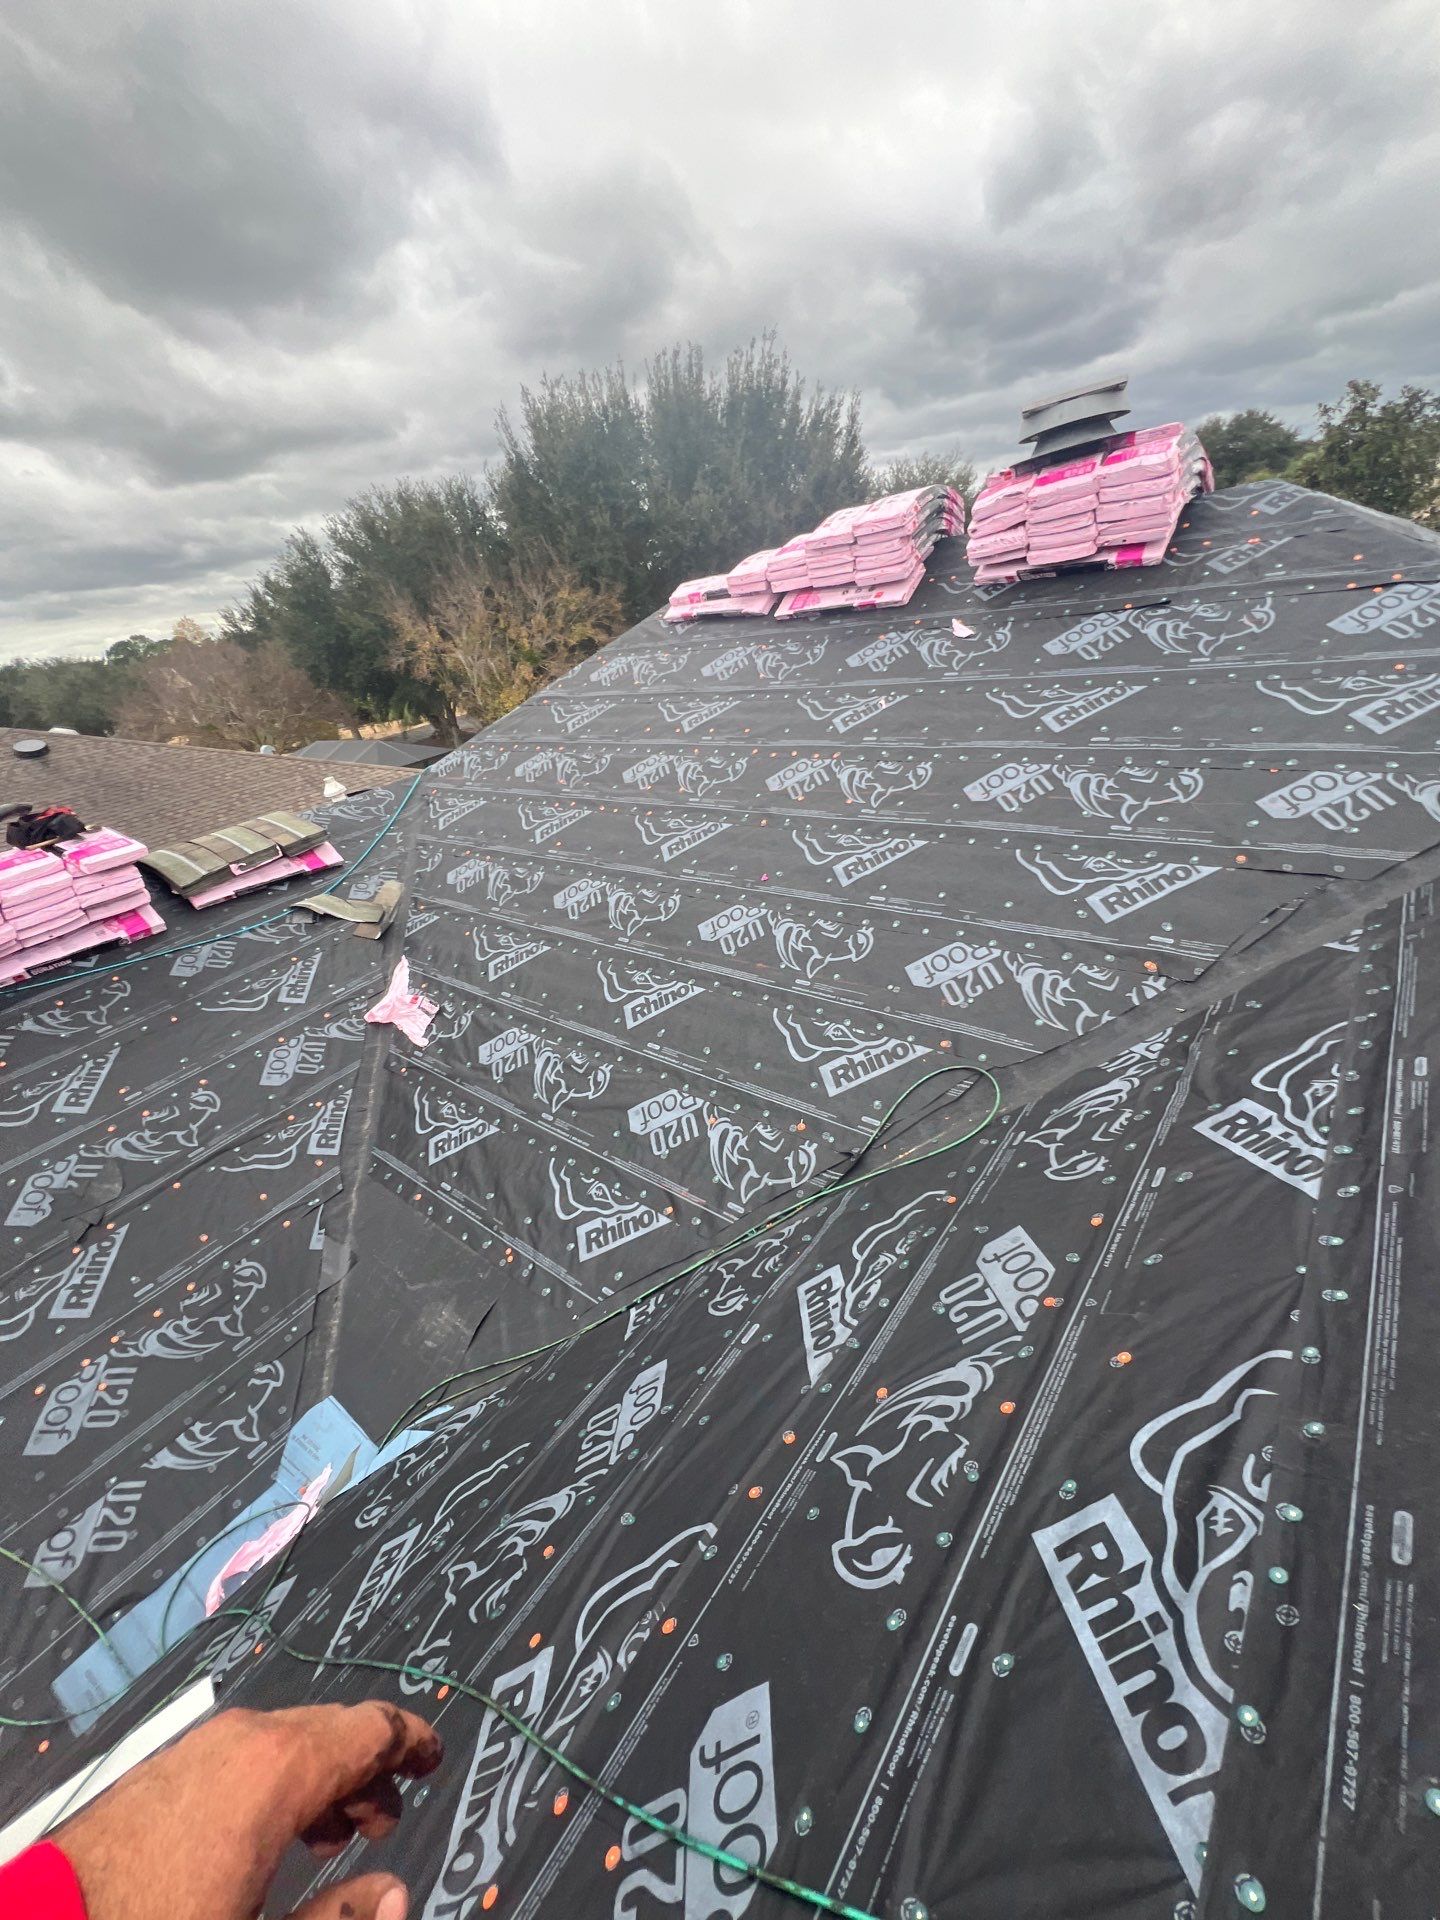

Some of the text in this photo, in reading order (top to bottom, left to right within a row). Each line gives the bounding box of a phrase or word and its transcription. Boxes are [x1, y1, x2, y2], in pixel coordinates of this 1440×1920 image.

[1348, 583, 1434, 631] Roof
[1076, 626, 1132, 660] U20
[996, 774, 1055, 812] U20
[1278, 772, 1375, 815] Roof
[1311, 786, 1397, 831] U20
[843, 840, 914, 878] Rhino
[1100, 865, 1200, 914] Rhino
[719, 919, 765, 955] U20
[923, 945, 993, 984] Roof
[940, 962, 1005, 1006] U20
[632, 985, 694, 1022] Rhino
[295, 1041, 326, 1075] U20
[492, 1046, 529, 1081] U20
[830, 1040, 916, 1088] Rhino
[315, 1092, 350, 1149] Rhino
[640, 1093, 698, 1132] Roof
[650, 1113, 699, 1156] U20
[434, 1121, 491, 1159] Rhino
[1210, 1110, 1325, 1177] Rhino
[585, 1208, 659, 1254] Rhino
[981, 1242, 1050, 1324] Roof
[804, 1275, 837, 1352] Rhino
[939, 1272, 1008, 1345] U20
[82, 1366, 138, 1428] U20
[618, 1376, 661, 1452] Roof
[574, 1403, 622, 1474] U20
[90, 1480, 147, 1552] U20
[1053, 1520, 1208, 1776] Rhino
[442, 1671, 536, 1897] Rhino
[699, 1733, 768, 1920] oof
